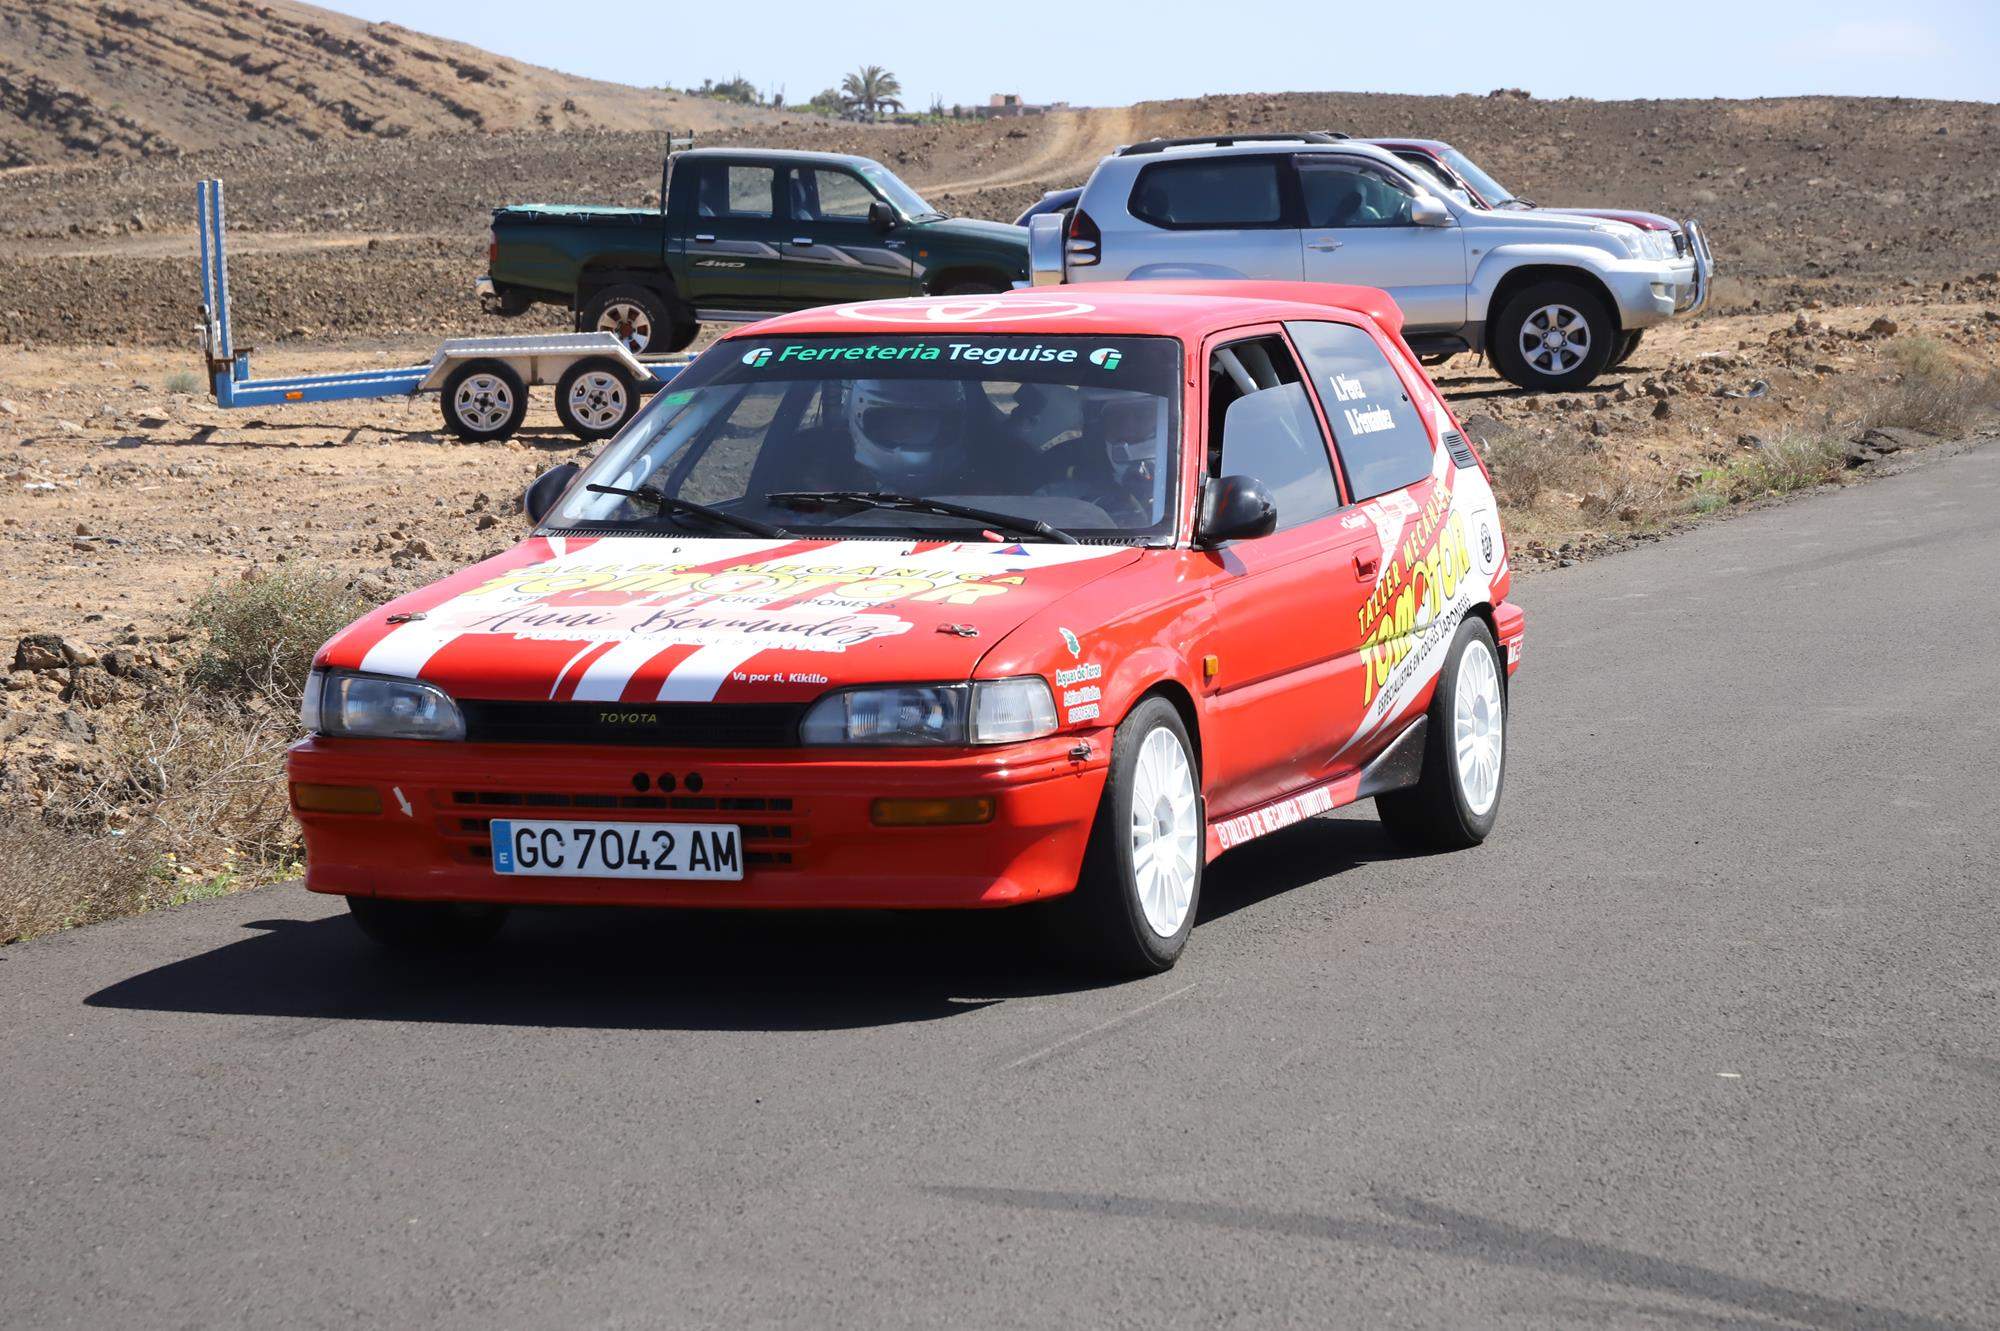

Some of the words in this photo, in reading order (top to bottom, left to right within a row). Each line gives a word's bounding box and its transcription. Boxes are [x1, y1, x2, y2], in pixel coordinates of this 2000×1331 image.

[696, 260, 747, 268] 4WD
[778, 343, 941, 362] Ferreteria
[948, 344, 1079, 365] Teguise
[459, 572, 1009, 605] TOMOTOR
[1358, 560, 1401, 638] TALLER
[1360, 509, 1470, 709] TOMOTOR
[1441, 592, 1472, 639] JAPONESES
[733, 672, 746, 681] Va
[749, 674, 770, 684] por
[774, 673, 785, 684] ti,
[789, 673, 829, 684] Kikillo
[600, 713, 657, 723] TOYOTA
[500, 852, 509, 864] E
[515, 828, 565, 869] GC
[573, 829, 678, 871] 7042
[689, 830, 739, 872] AM
